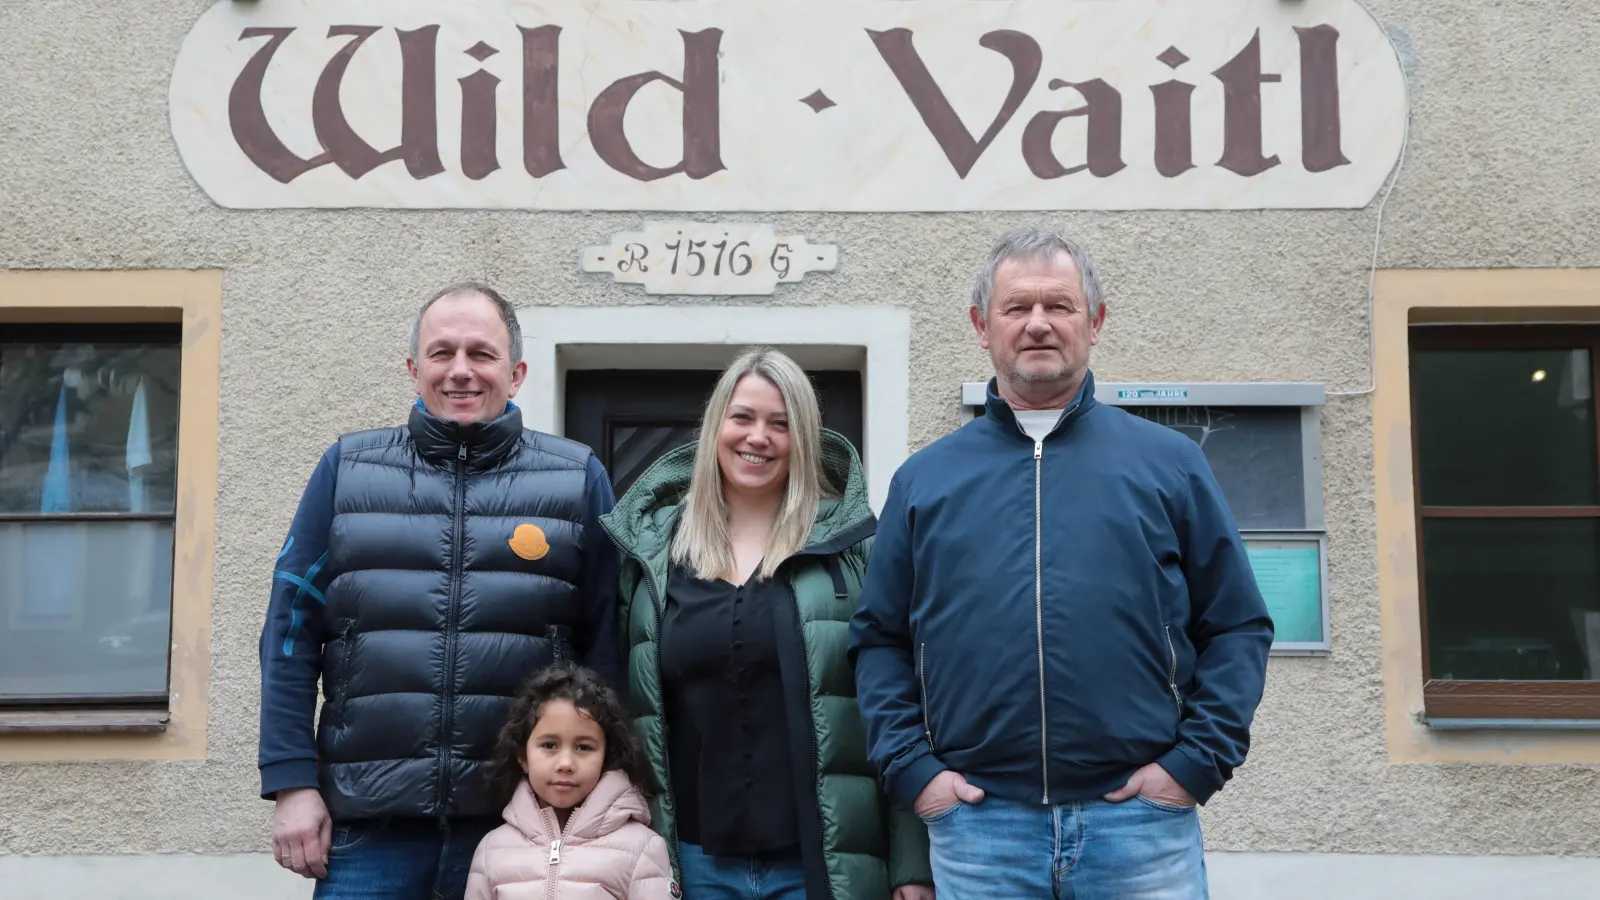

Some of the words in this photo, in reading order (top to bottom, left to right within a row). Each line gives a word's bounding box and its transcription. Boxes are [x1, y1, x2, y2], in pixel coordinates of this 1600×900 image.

[228, 24, 728, 184] Wild
[864, 24, 1352, 180] Vaitl
[617, 243, 649, 273] R
[665, 230, 753, 277] 1516
